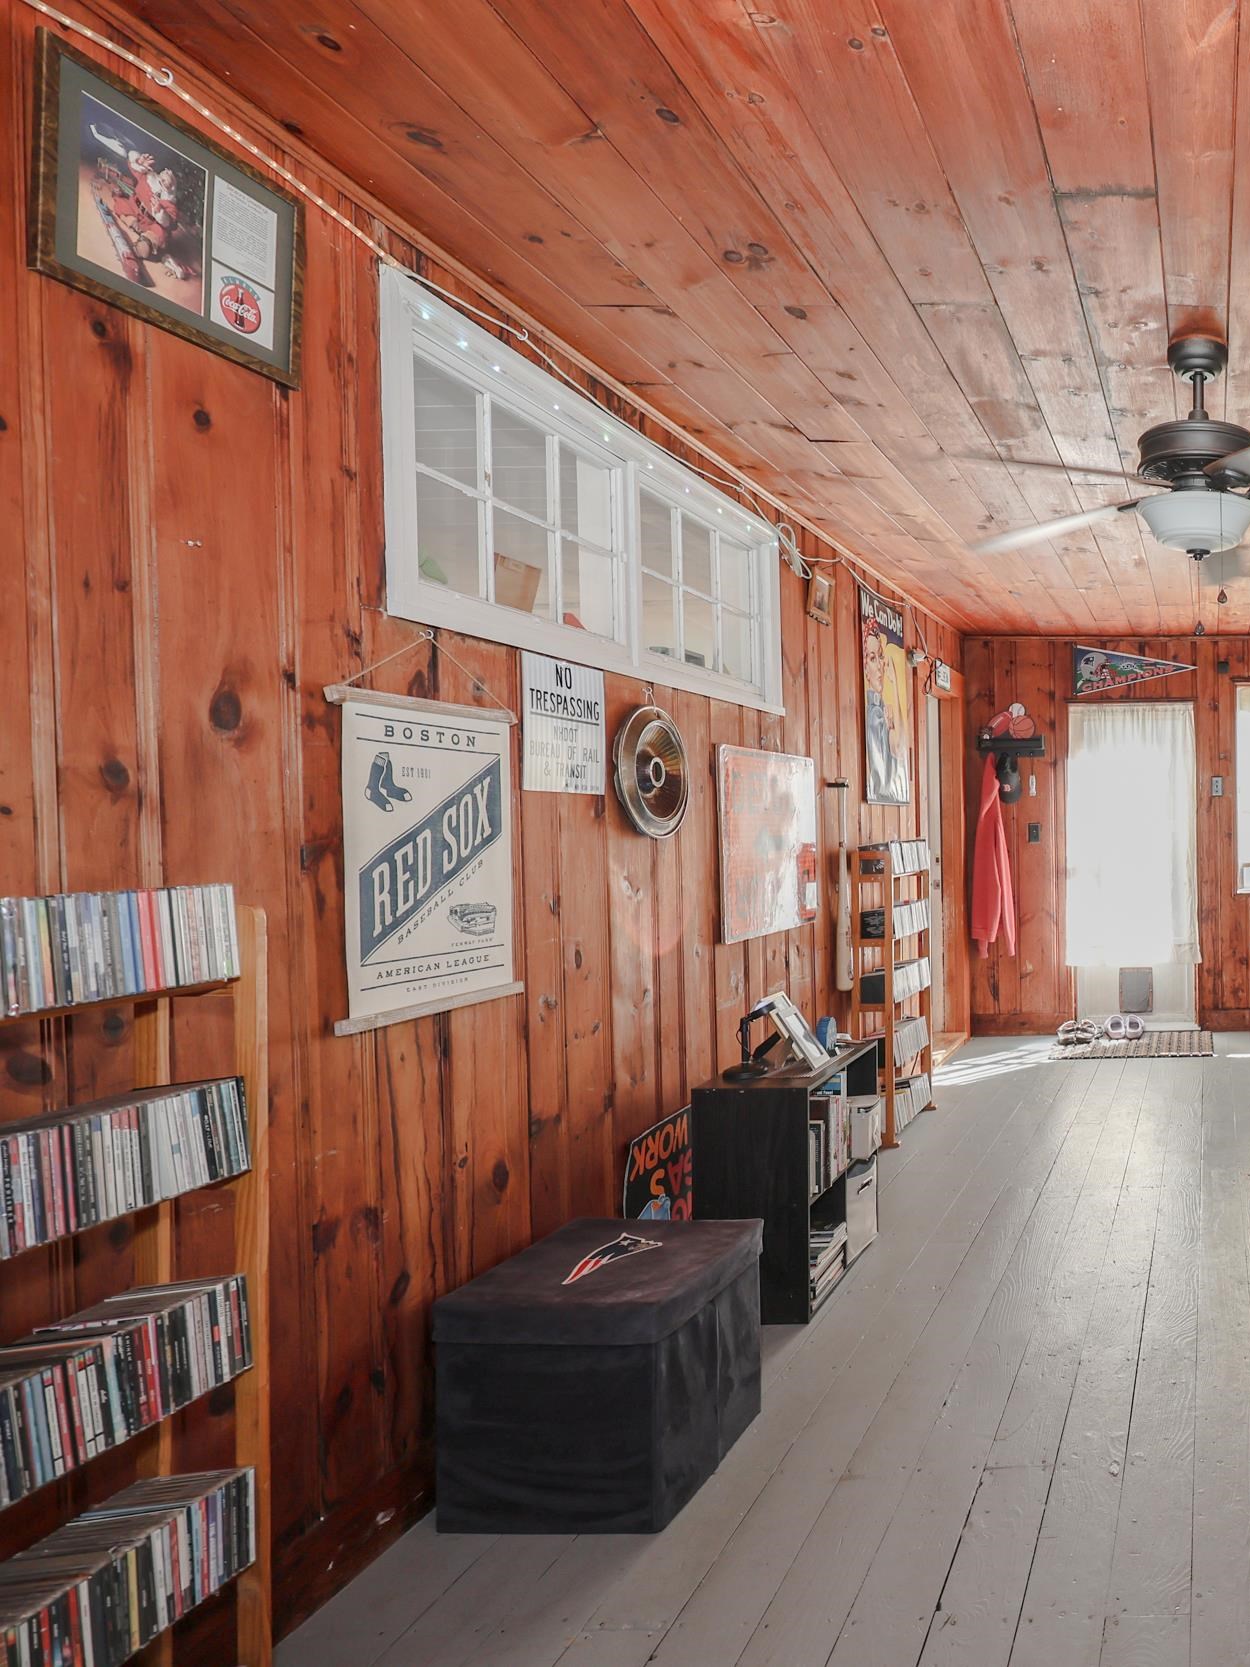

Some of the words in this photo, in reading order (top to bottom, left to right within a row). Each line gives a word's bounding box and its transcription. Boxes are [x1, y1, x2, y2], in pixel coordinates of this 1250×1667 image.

[861, 590, 874, 617] We
[874, 600, 888, 627] Can
[887, 607, 897, 632] Do
[555, 664, 572, 689] NO
[1081, 665, 1174, 692] CHAMPIONS
[529, 688, 600, 721] TRESPASSING
[384, 725, 476, 747] BOSTON
[553, 726, 578, 743] NHDOT
[529, 740, 560, 759] BUREAU
[567, 746, 577, 760] OF
[583, 748, 600, 763] RAIL
[401, 766, 414, 777] EST
[543, 763, 551, 776] &
[556, 761, 586, 779] TRANSIT
[372, 829, 432, 938] RED
[442, 776, 492, 875] SOX
[397, 889, 454, 945] BASEBALL
[458, 859, 484, 887] CLUB
[377, 963, 440, 980] AMERICAN
[446, 955, 490, 968] LEAGUE
[406, 984, 428, 992] EAST
[629, 1113, 688, 1182] WORK
